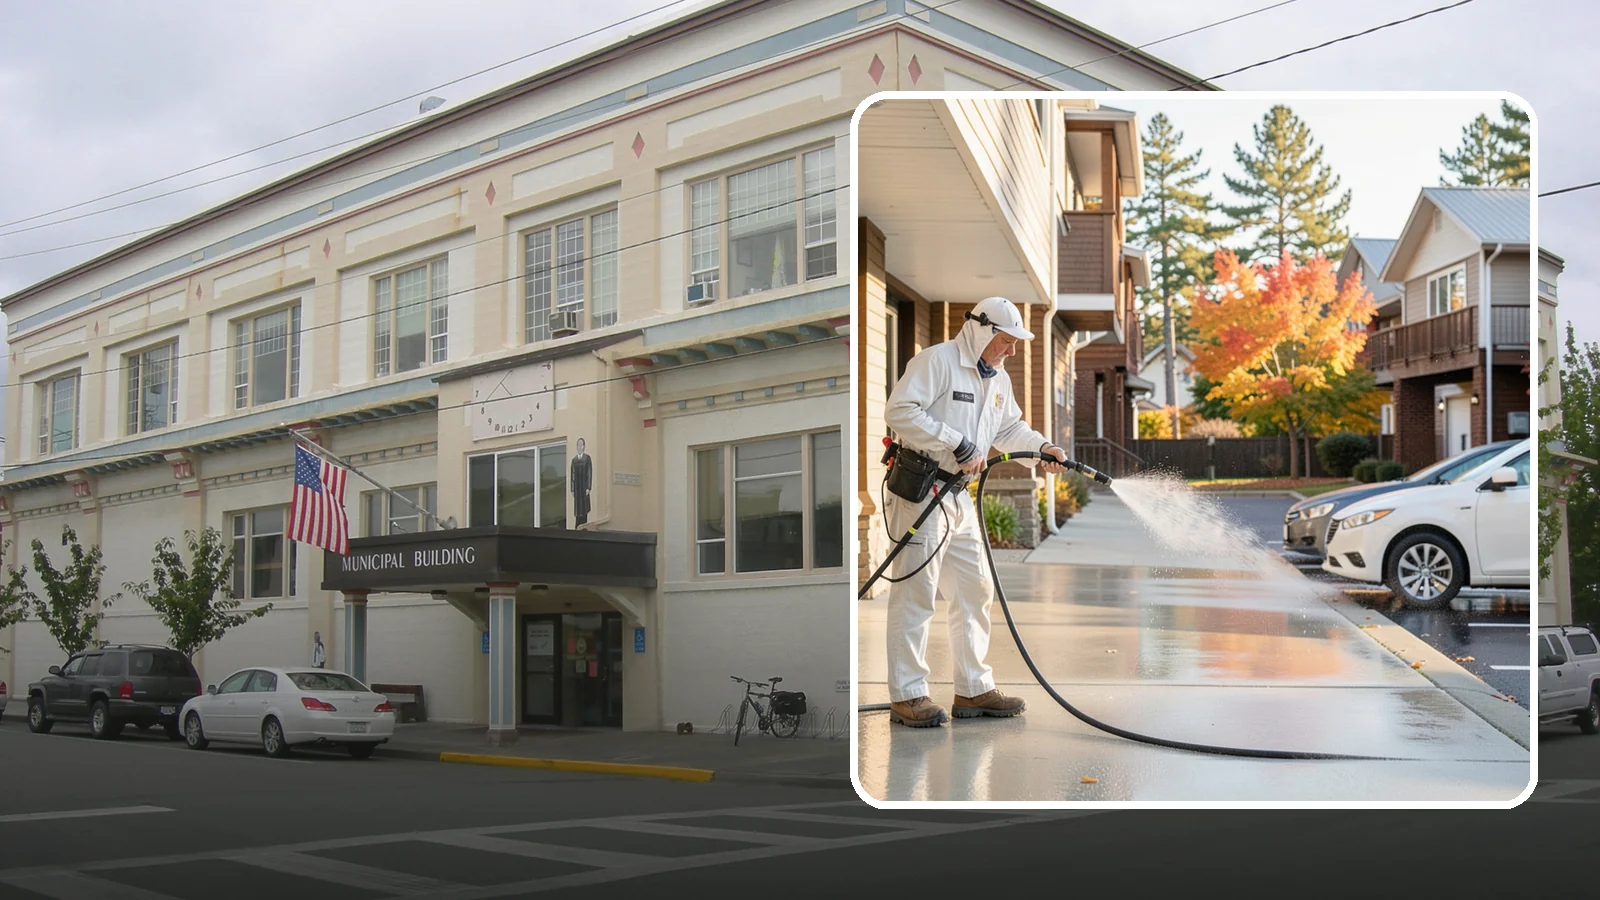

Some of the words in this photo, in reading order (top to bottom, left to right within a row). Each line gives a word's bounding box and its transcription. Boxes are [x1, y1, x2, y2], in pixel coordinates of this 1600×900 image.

[480, 406, 485, 415] 8
[488, 417, 493, 426] 9
[494, 423, 500, 432] 10
[501, 425, 506, 433] 11
[507, 425, 513, 433] 12
[521, 420, 526, 428] 2
[528, 413, 533, 422] 3
[536, 402, 540, 410] 4
[342, 552, 405, 572] MUNICIPAL
[414, 546, 475, 567] BUILDING
